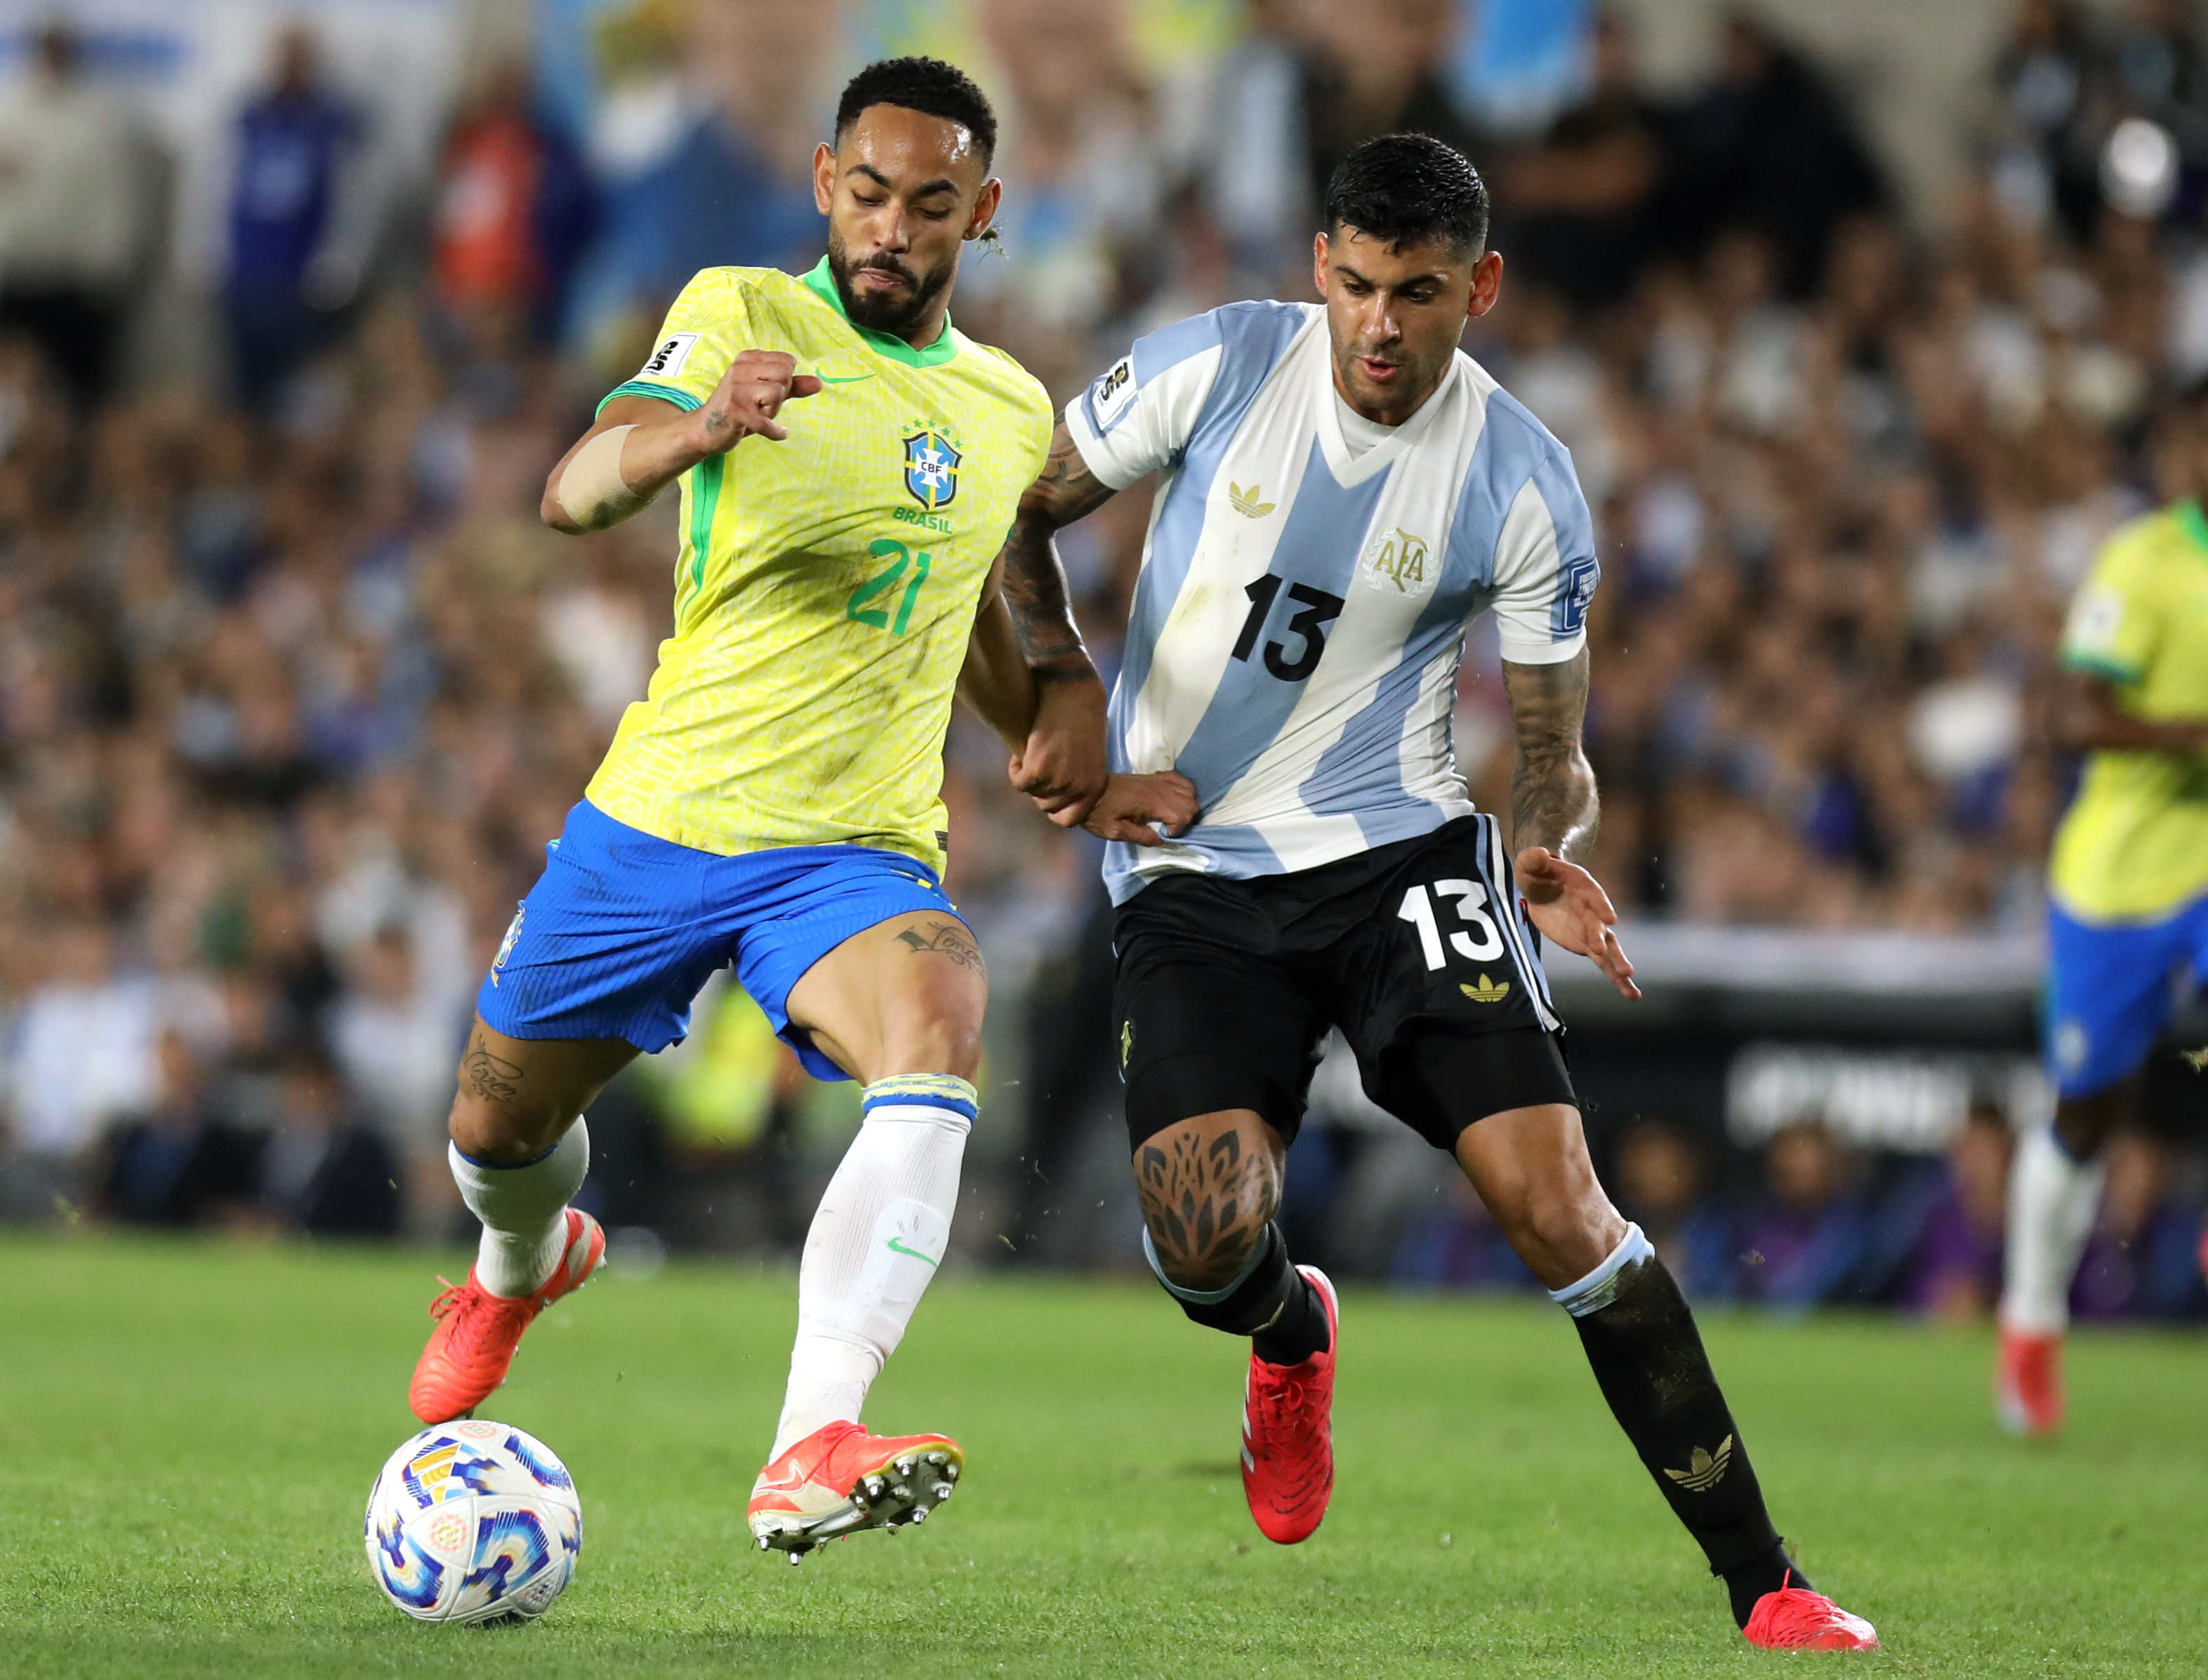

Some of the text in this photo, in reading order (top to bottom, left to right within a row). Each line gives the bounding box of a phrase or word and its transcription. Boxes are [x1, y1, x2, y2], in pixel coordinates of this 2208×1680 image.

[920, 461, 942, 475] CBF
[892, 506, 953, 535] BRASIL
[1373, 527, 1429, 593] AFA
[847, 539, 932, 637] 21
[1231, 572, 1346, 682] 13
[1397, 879, 1505, 971] 13
